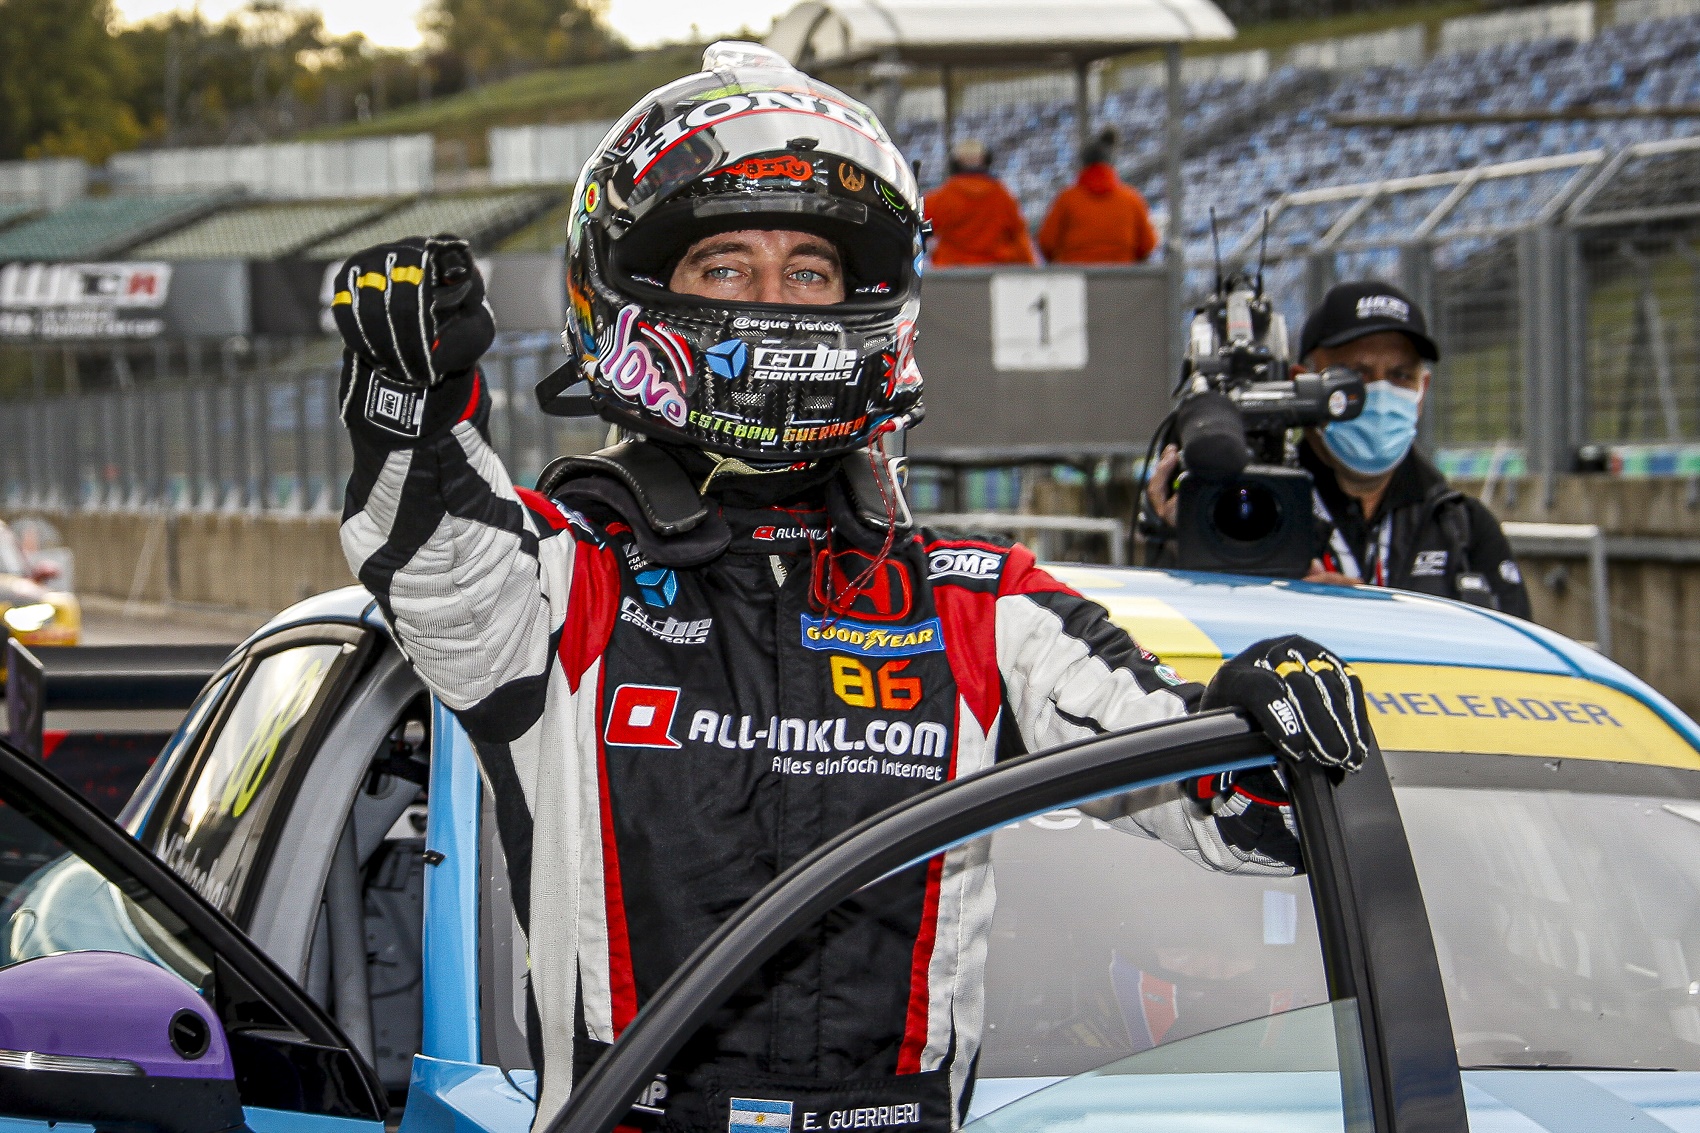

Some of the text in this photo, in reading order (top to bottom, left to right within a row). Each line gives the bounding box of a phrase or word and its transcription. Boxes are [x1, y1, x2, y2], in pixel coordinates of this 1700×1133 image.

[1027, 293, 1051, 348] 1
[599, 304, 688, 427] love
[752, 370, 853, 382] CONTROLS
[383, 393, 396, 416] OMP
[688, 409, 777, 442] ESTEBAN
[928, 553, 1001, 576] OMP
[806, 624, 935, 651] GOODYEAR
[829, 655, 924, 712] 86
[1271, 699, 1298, 735] OMP
[802, 1102, 921, 1131] E. GUERRIERI
